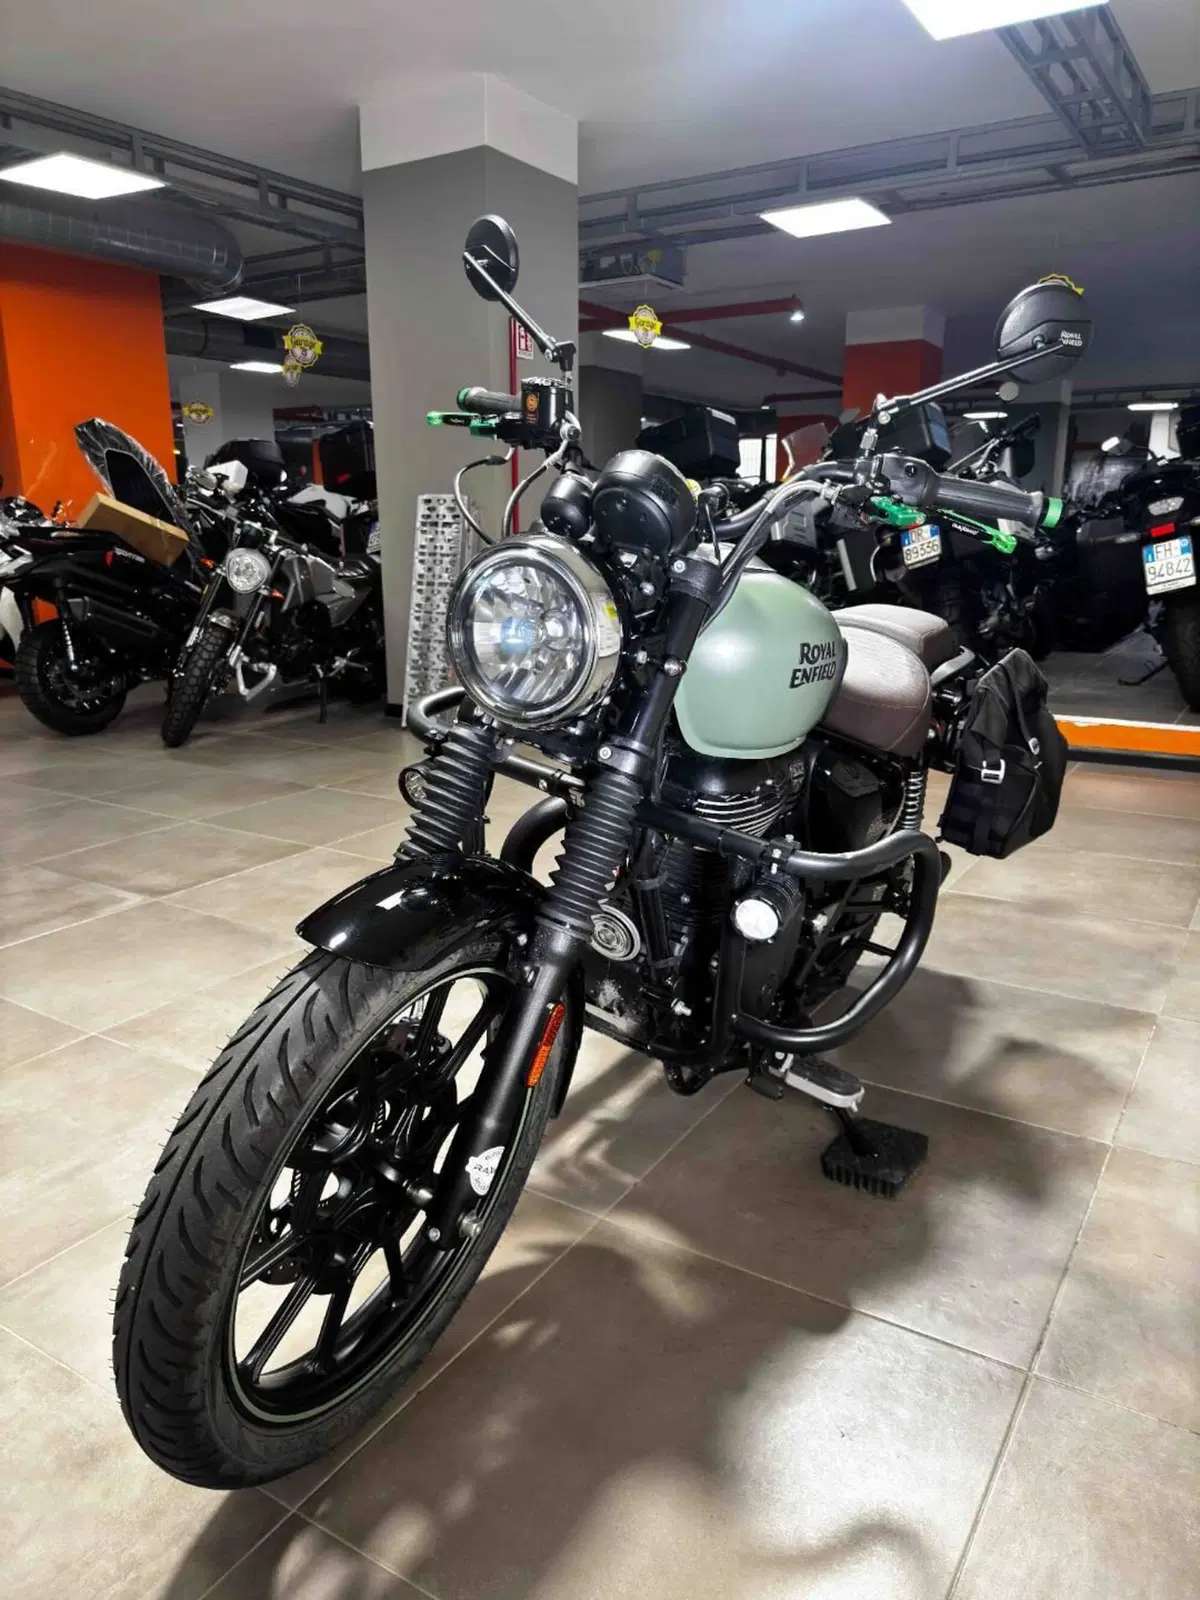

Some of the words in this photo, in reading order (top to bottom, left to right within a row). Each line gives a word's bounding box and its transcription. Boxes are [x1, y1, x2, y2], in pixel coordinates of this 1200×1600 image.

[905, 541, 939, 561] 89336
[1155, 542, 1172, 560] FH
[1148, 558, 1191, 580] 94842
[799, 641, 836, 665] ROYAL
[789, 661, 836, 689] ENFIELD
